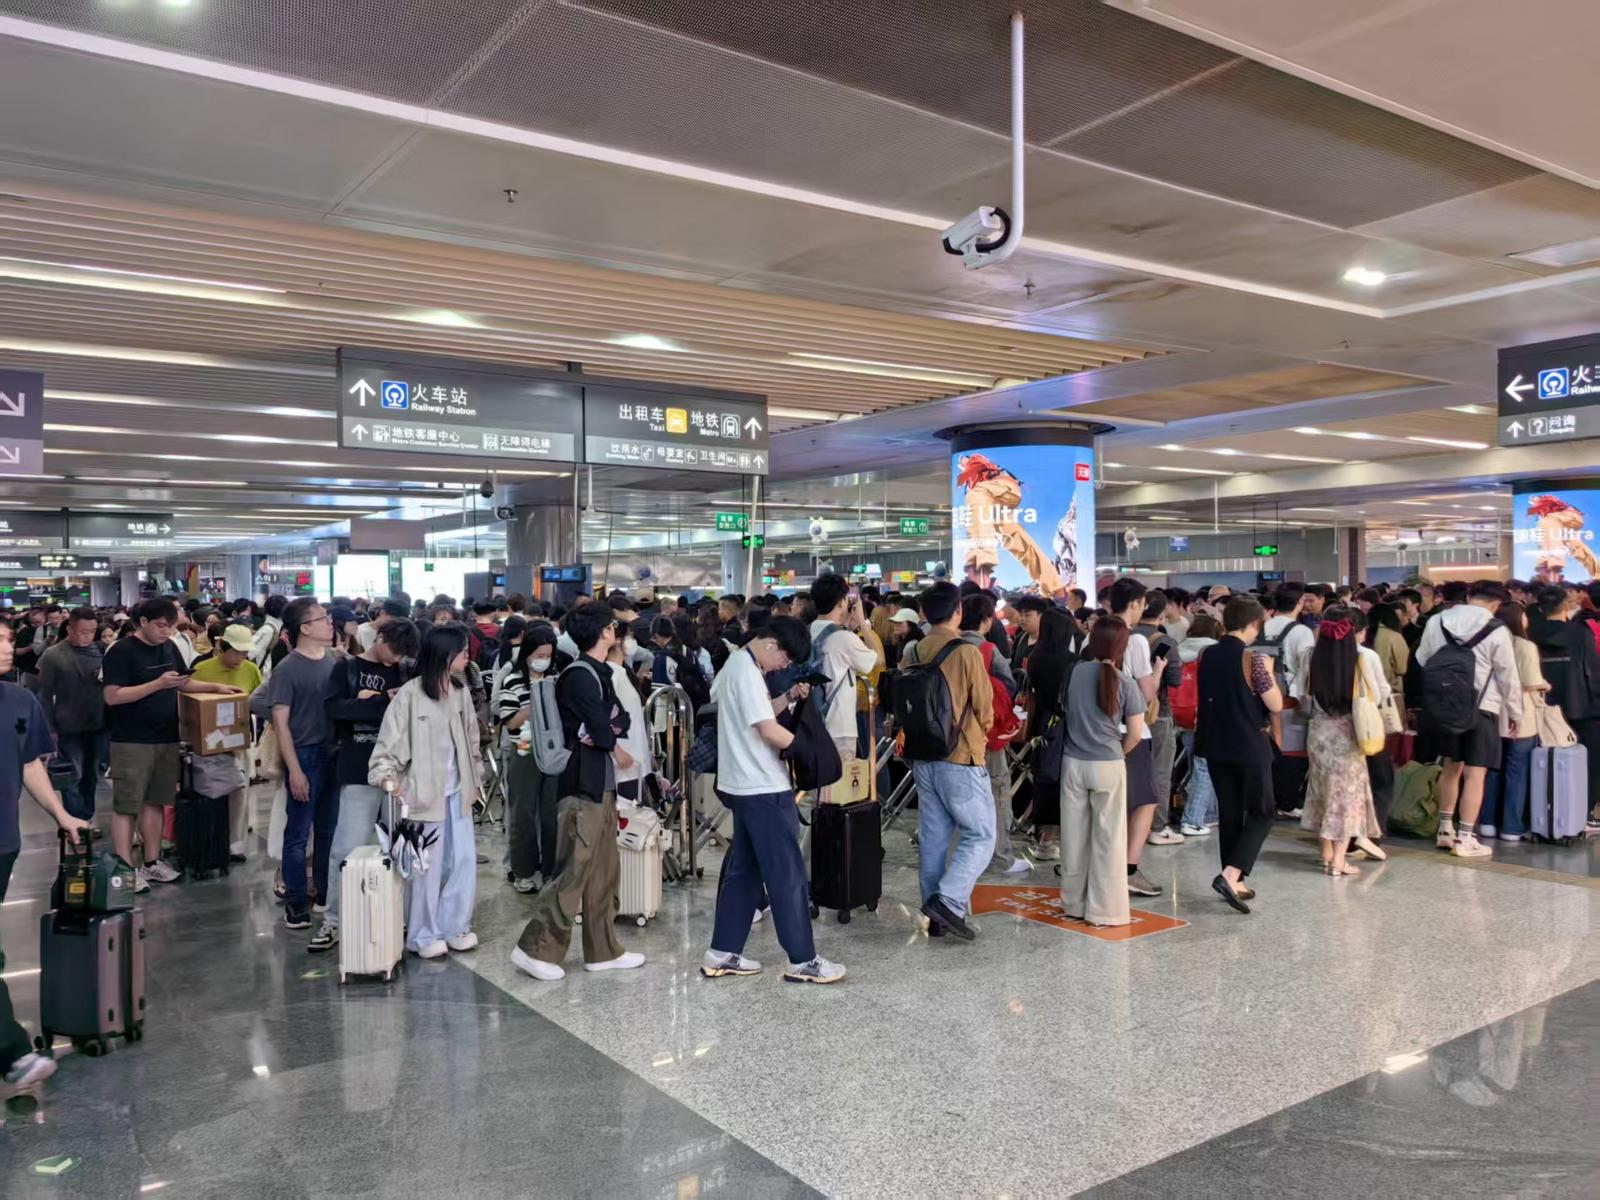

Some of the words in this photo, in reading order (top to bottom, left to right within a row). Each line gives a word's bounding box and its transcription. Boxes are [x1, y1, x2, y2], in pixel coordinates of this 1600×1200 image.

[412, 384, 468, 406] 火车站
[411, 402, 444, 415] Railway
[446, 405, 477, 416] Station
[619, 403, 665, 423] 出租车
[649, 423, 665, 431] Taxi
[691, 410, 719, 429] 地铁
[391, 426, 460, 442] 地铁客服中心
[700, 428, 720, 436] Metro
[700, 450, 726, 460] 卫生间
[979, 504, 1038, 524] Ultra
